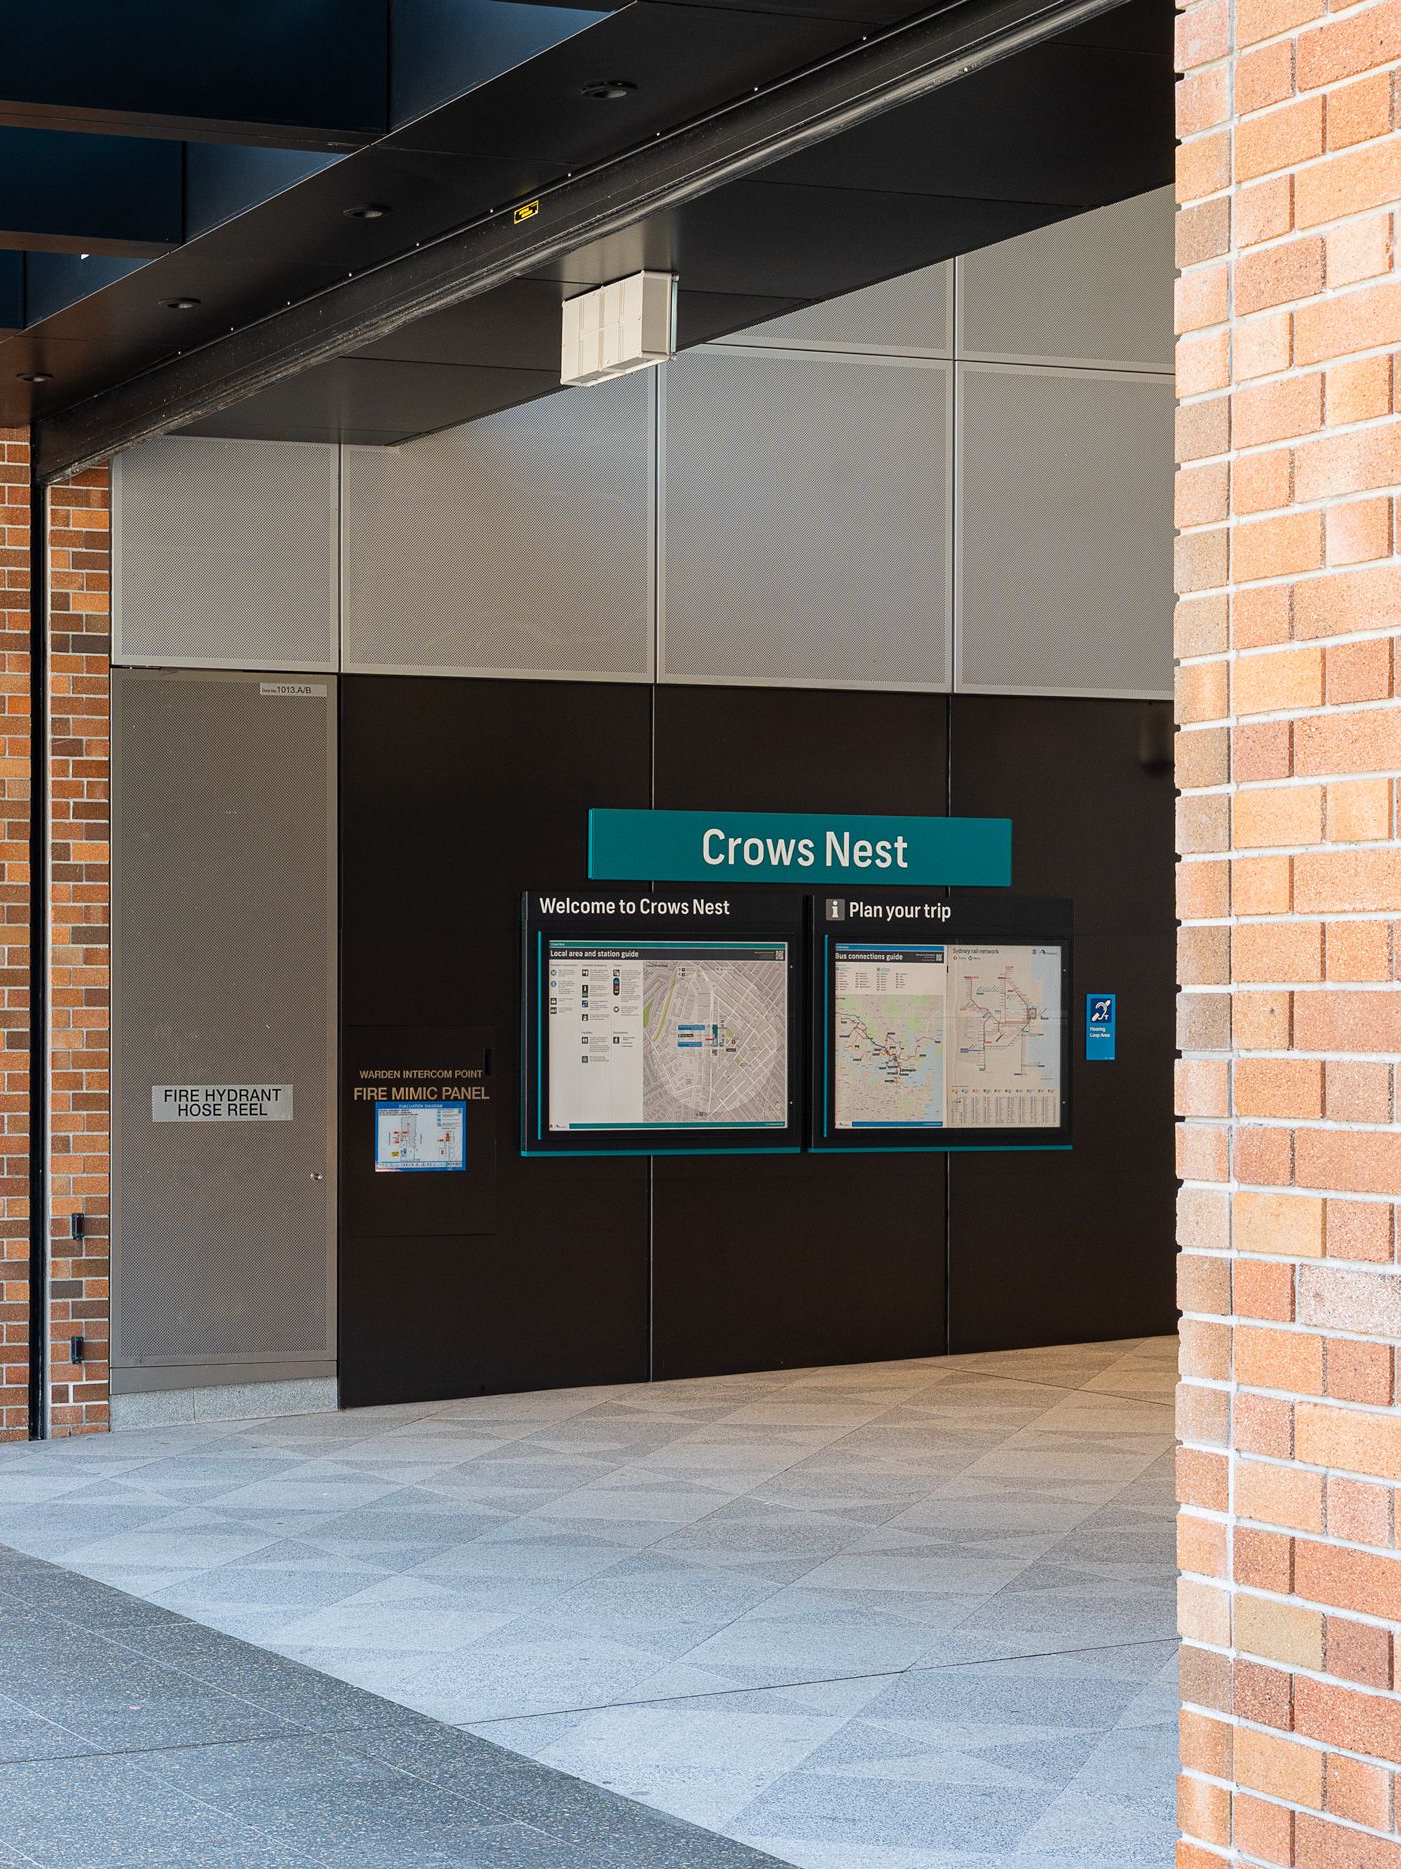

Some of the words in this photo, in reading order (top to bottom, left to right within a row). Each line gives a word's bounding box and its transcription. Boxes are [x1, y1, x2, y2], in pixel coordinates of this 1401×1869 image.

[702, 828, 814, 867] Crows
[825, 831, 908, 868] Nest
[539, 898, 615, 914] Welcome
[619, 900, 636, 914] to
[640, 898, 689, 915] Crows
[693, 899, 730, 915] Nest
[849, 901, 883, 918] Plan
[886, 905, 921, 922] your
[924, 902, 951, 923] trip
[621, 950, 639, 959] guide
[886, 953, 903, 961] guide
[359, 1070, 401, 1079] WARDEN
[402, 1070, 452, 1078] INTERCOM
[454, 1070, 483, 1078] POINT
[164, 1089, 200, 1102] FIRE
[205, 1088, 282, 1102] HYDRANT
[353, 1087, 388, 1101] FIRE
[391, 1087, 438, 1101] MIMIC
[442, 1086, 490, 1100] PANEL
[178, 1103, 222, 1117] HOSE
[227, 1103, 268, 1116] REEL
